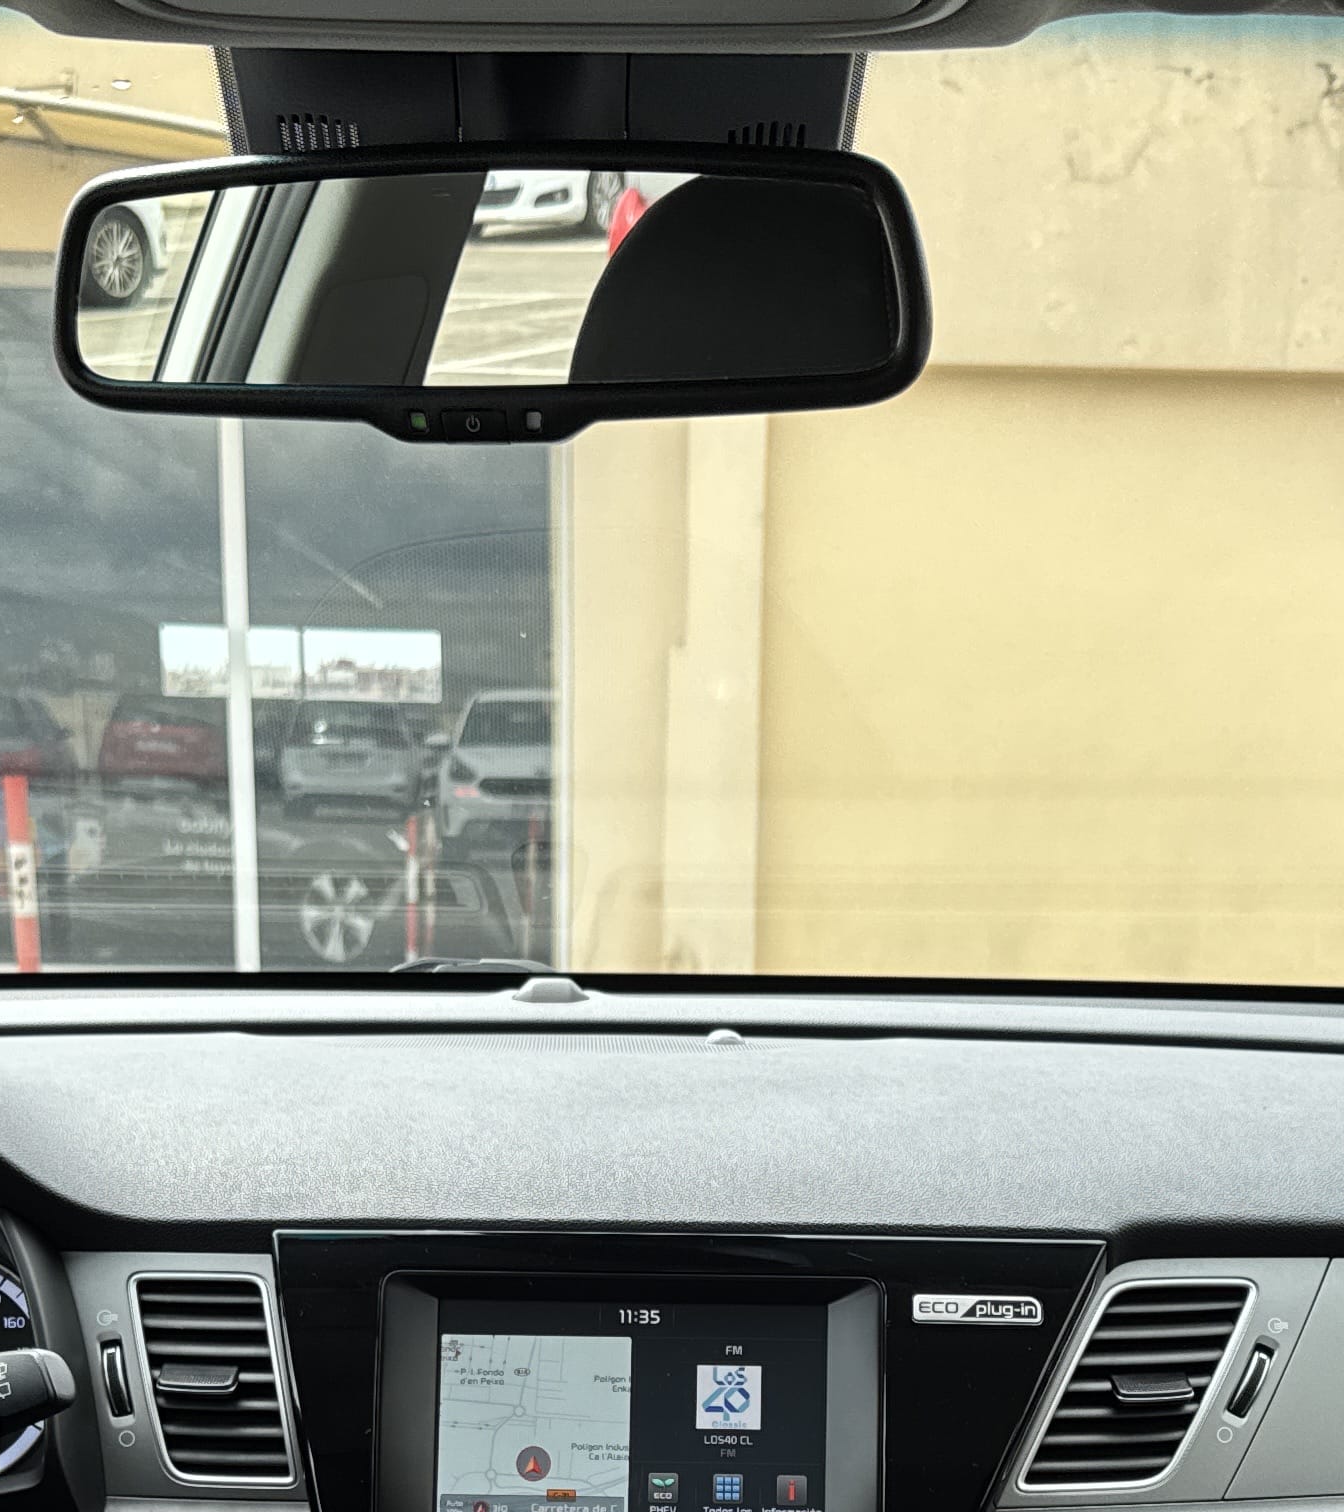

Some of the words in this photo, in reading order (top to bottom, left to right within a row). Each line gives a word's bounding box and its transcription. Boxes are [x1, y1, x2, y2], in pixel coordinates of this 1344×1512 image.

[918, 1301, 959, 1314] ECO
[975, 1301, 1036, 1319] plug-in
[3, 1316, 26, 1329] 160
[619, 1309, 661, 1325] 11:35
[725, 1345, 743, 1356] FM
[704, 1435, 738, 1446] LOS40
[740, 1436, 754, 1446] CL
[720, 1449, 737, 1458] FM
